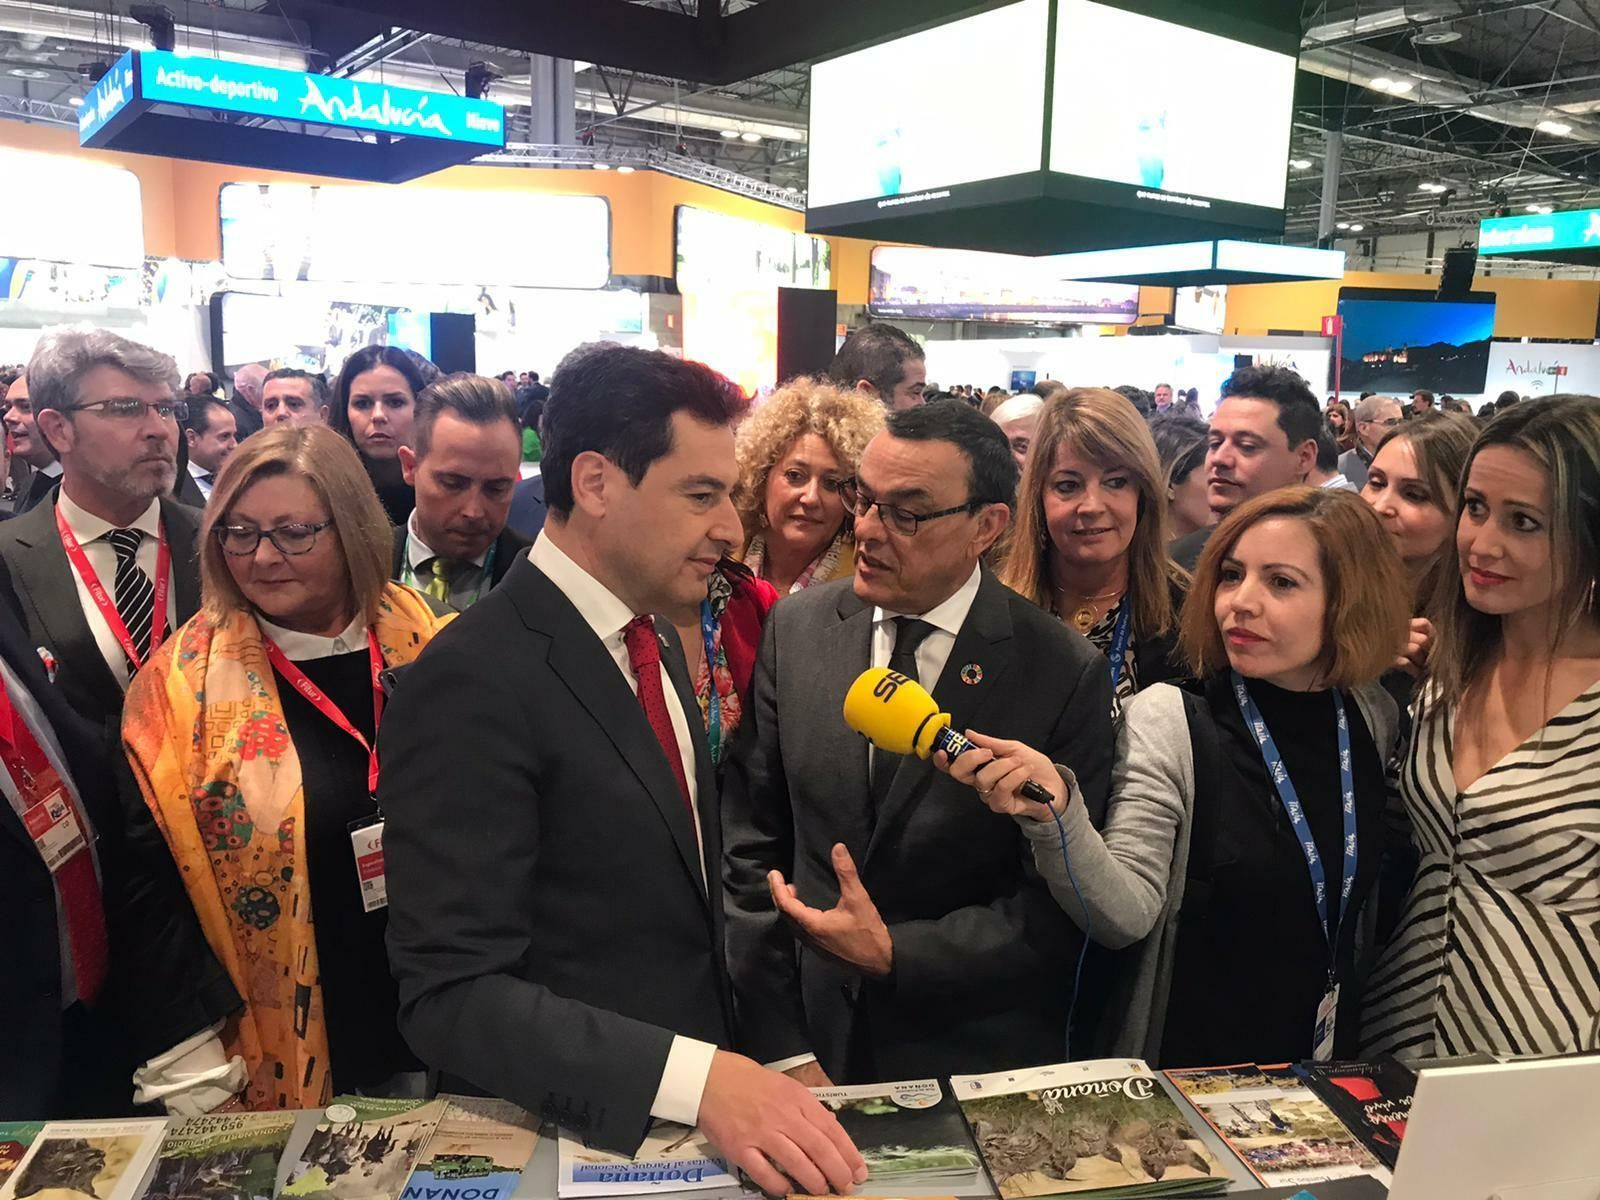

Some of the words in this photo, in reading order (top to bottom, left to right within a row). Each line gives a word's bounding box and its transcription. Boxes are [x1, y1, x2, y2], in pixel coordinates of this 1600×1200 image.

[156, 65, 278, 103] Activo-deportivo
[299, 76, 452, 136] Andalucía
[1042, 1075, 1155, 1101] Doñana
[171, 1125, 217, 1136] 442474
[220, 1121, 244, 1131] 959
[580, 1164, 629, 1172] Nacional
[632, 1162, 671, 1170] Parque
[600, 1167, 704, 1185] Doñana
